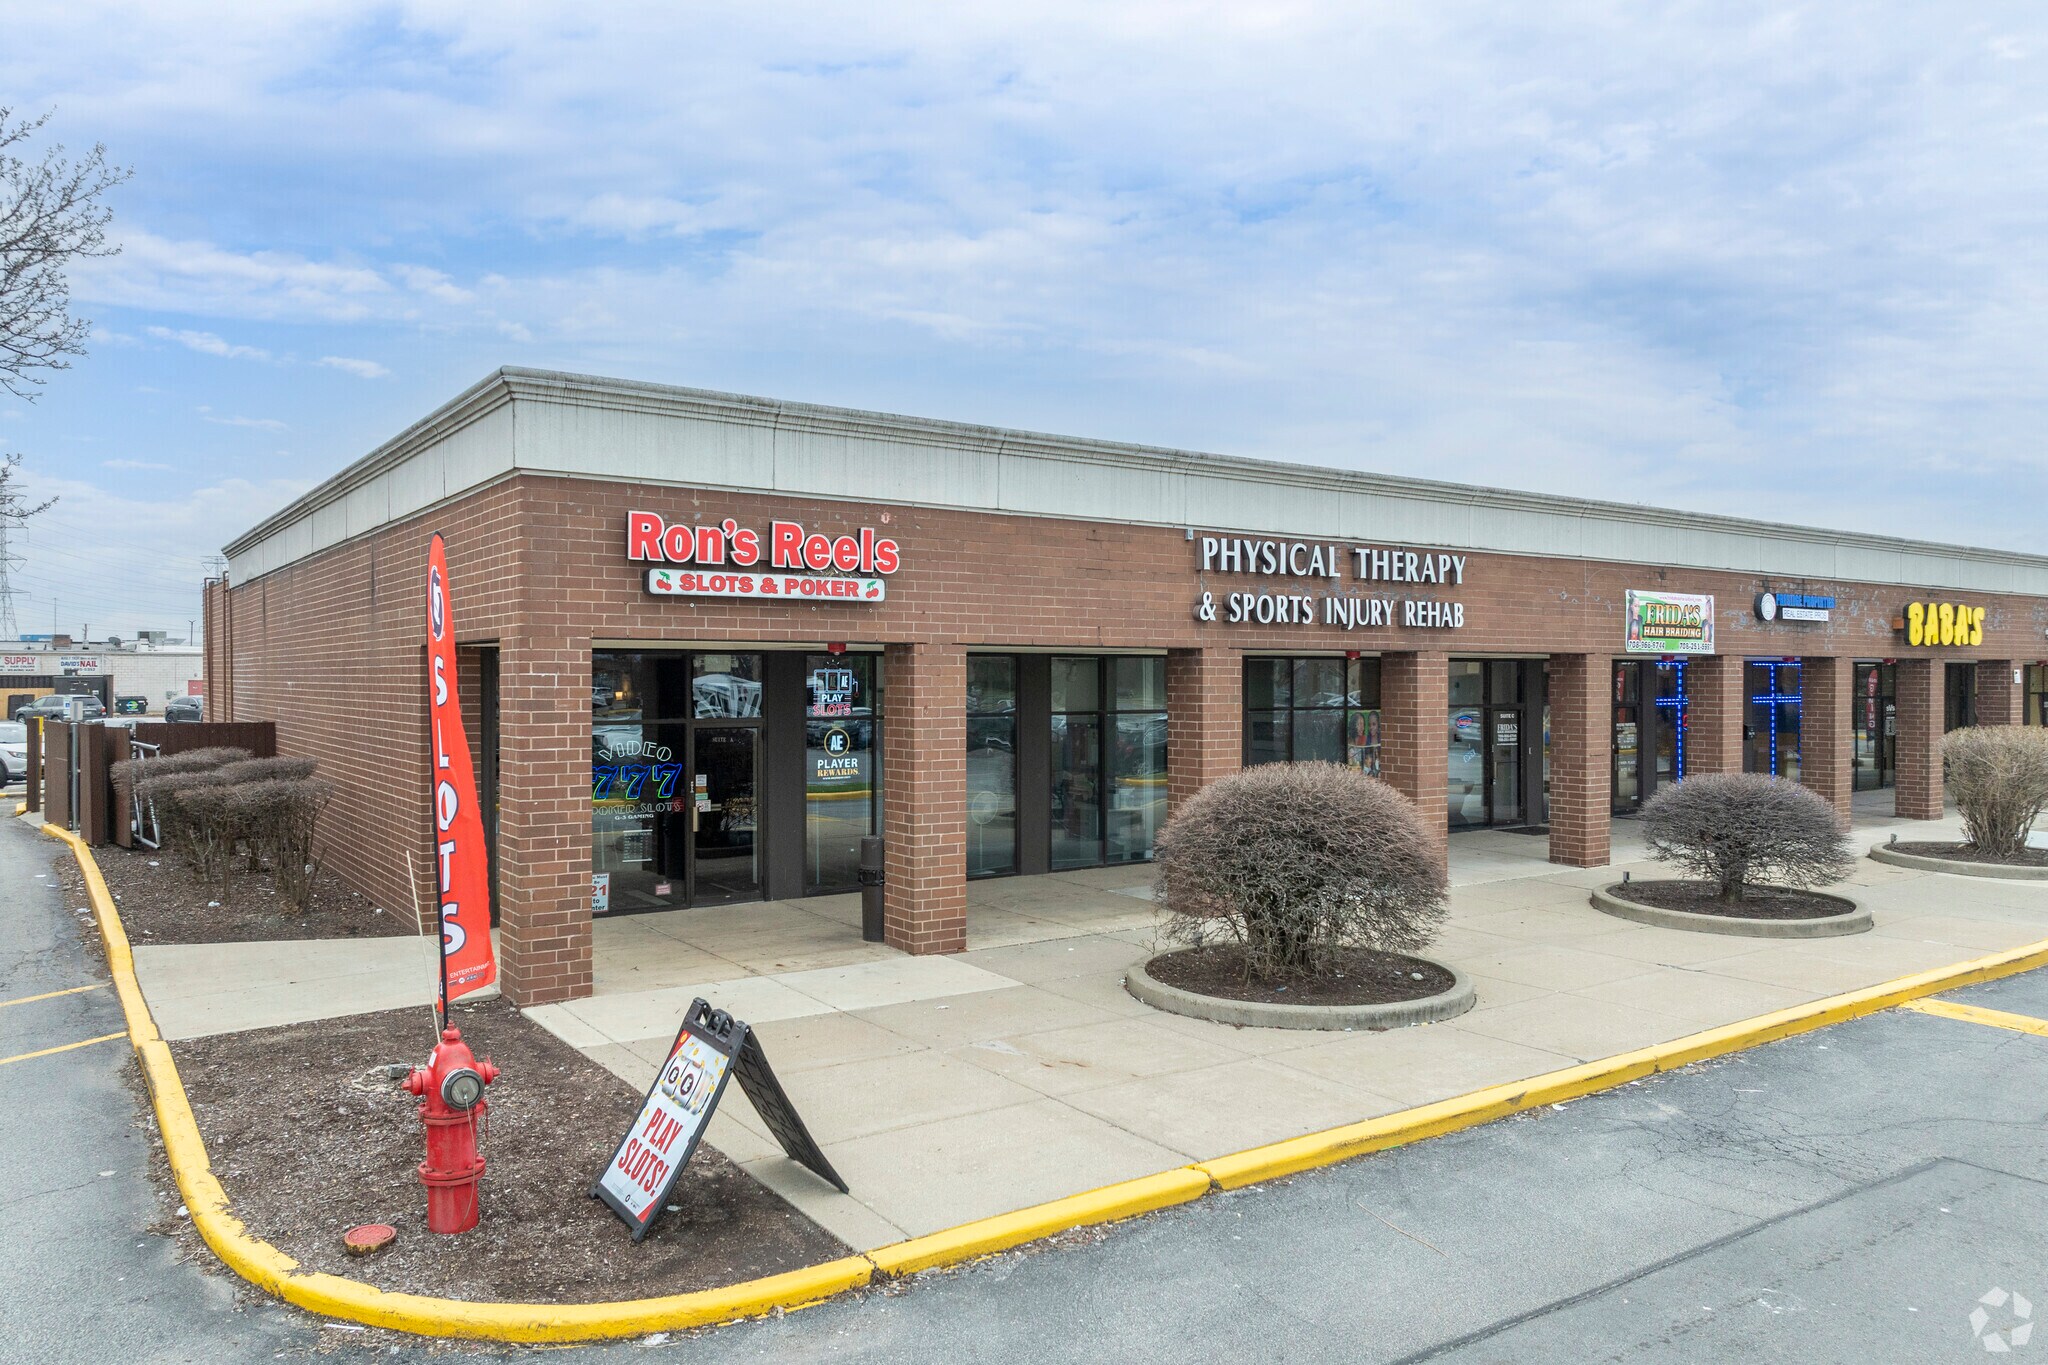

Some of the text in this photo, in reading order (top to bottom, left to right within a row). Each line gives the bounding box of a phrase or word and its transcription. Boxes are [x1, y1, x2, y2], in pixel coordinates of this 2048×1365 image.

[627, 510, 900, 575] Ron's Reels
[1202, 537, 1466, 584] PHYSICAL THERAPY
[679, 573, 859, 597] SLOTS & POKER
[1200, 591, 1464, 630] & SPORTS INJURY REHAB
[1645, 602, 1701, 626] FRIDA'S
[1784, 609, 1827, 620] REAL ESTATE PROS
[1643, 626, 1701, 638] HAIR BRAIDING
[1908, 601, 1985, 646] BABA'S
[4, 656, 36, 665] SUPPLY
[80, 660, 98, 668] NAIL
[812, 703, 852, 716] SLOTS
[821, 694, 844, 703] PLAY
[598, 740, 672, 762] VIDEO
[817, 758, 859, 769] PLAYER
[592, 763, 683, 802] 777
[434, 653, 467, 956] SLOTS
[640, 801, 681, 813] SLOTS
[592, 884, 607, 896] 21
[642, 1107, 683, 1155] PLAY
[618, 1138, 670, 1197] SLOTS!
